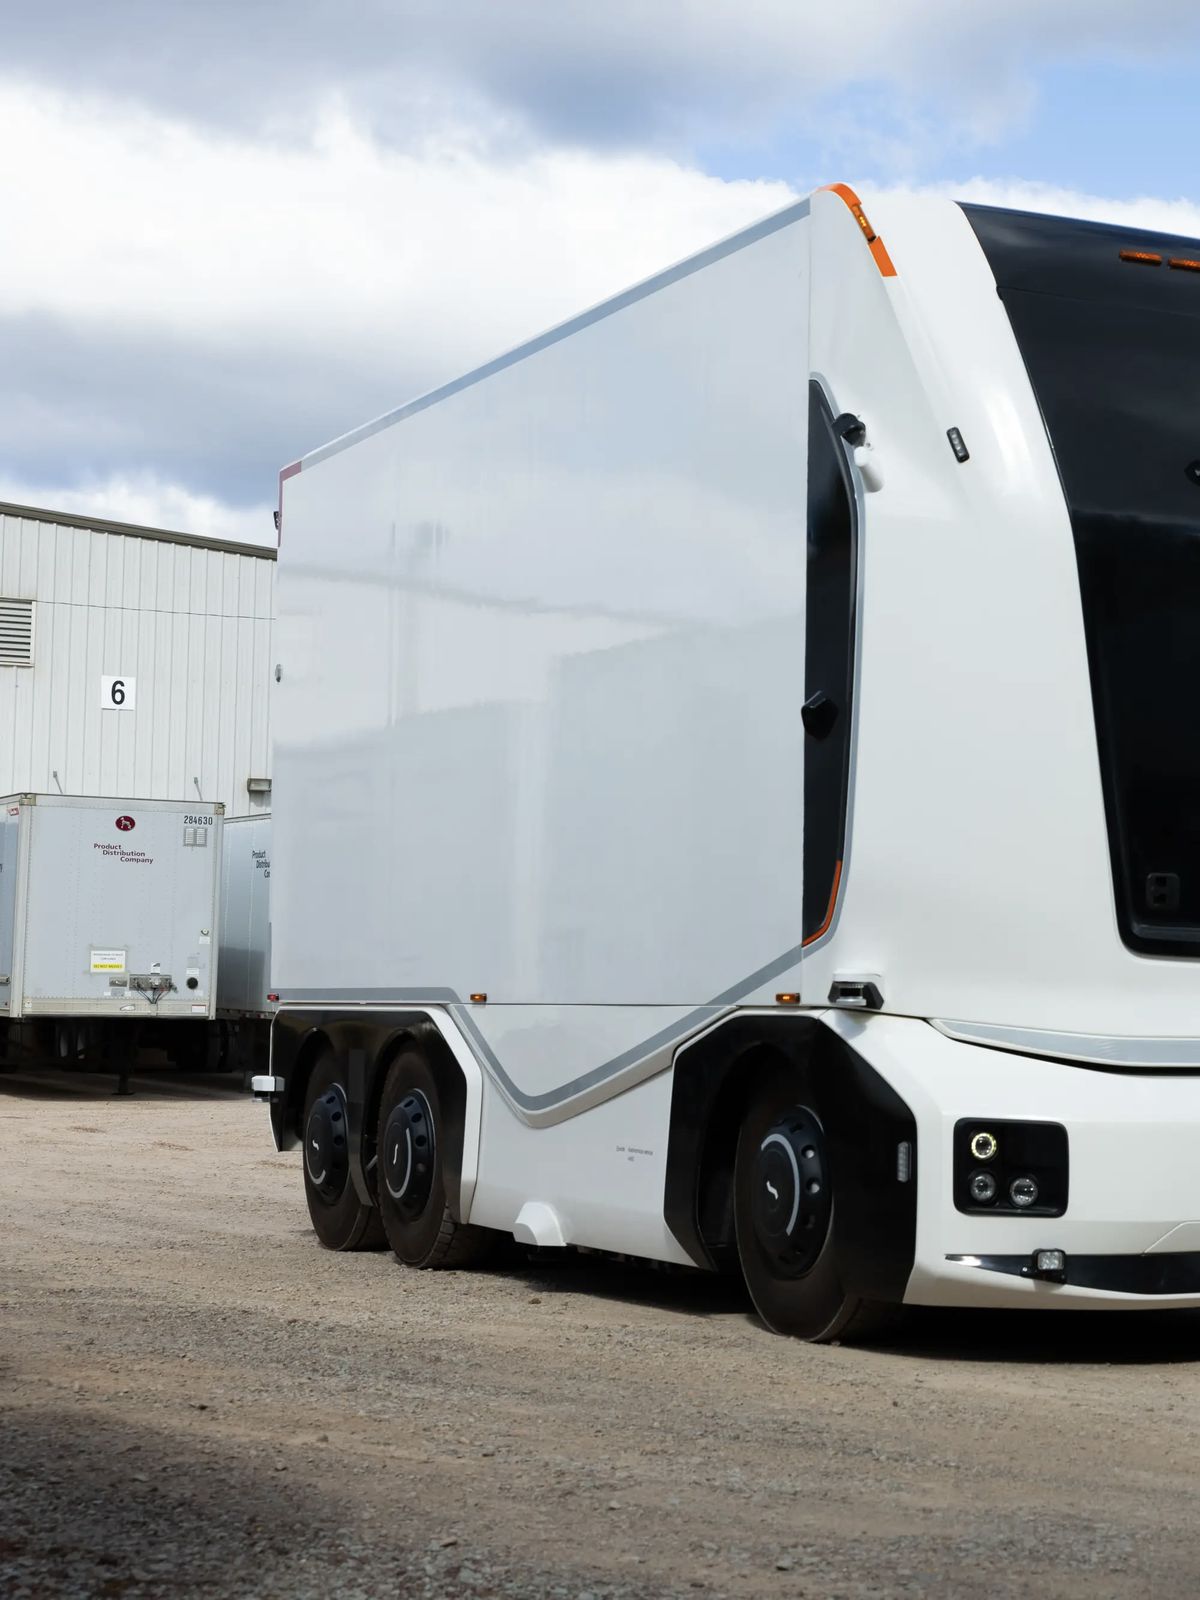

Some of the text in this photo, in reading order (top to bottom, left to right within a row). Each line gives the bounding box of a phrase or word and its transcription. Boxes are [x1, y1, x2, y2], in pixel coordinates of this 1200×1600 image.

[111, 680, 125, 705] 6
[183, 815, 213, 825] 284630
[120, 856, 154, 864] Company
